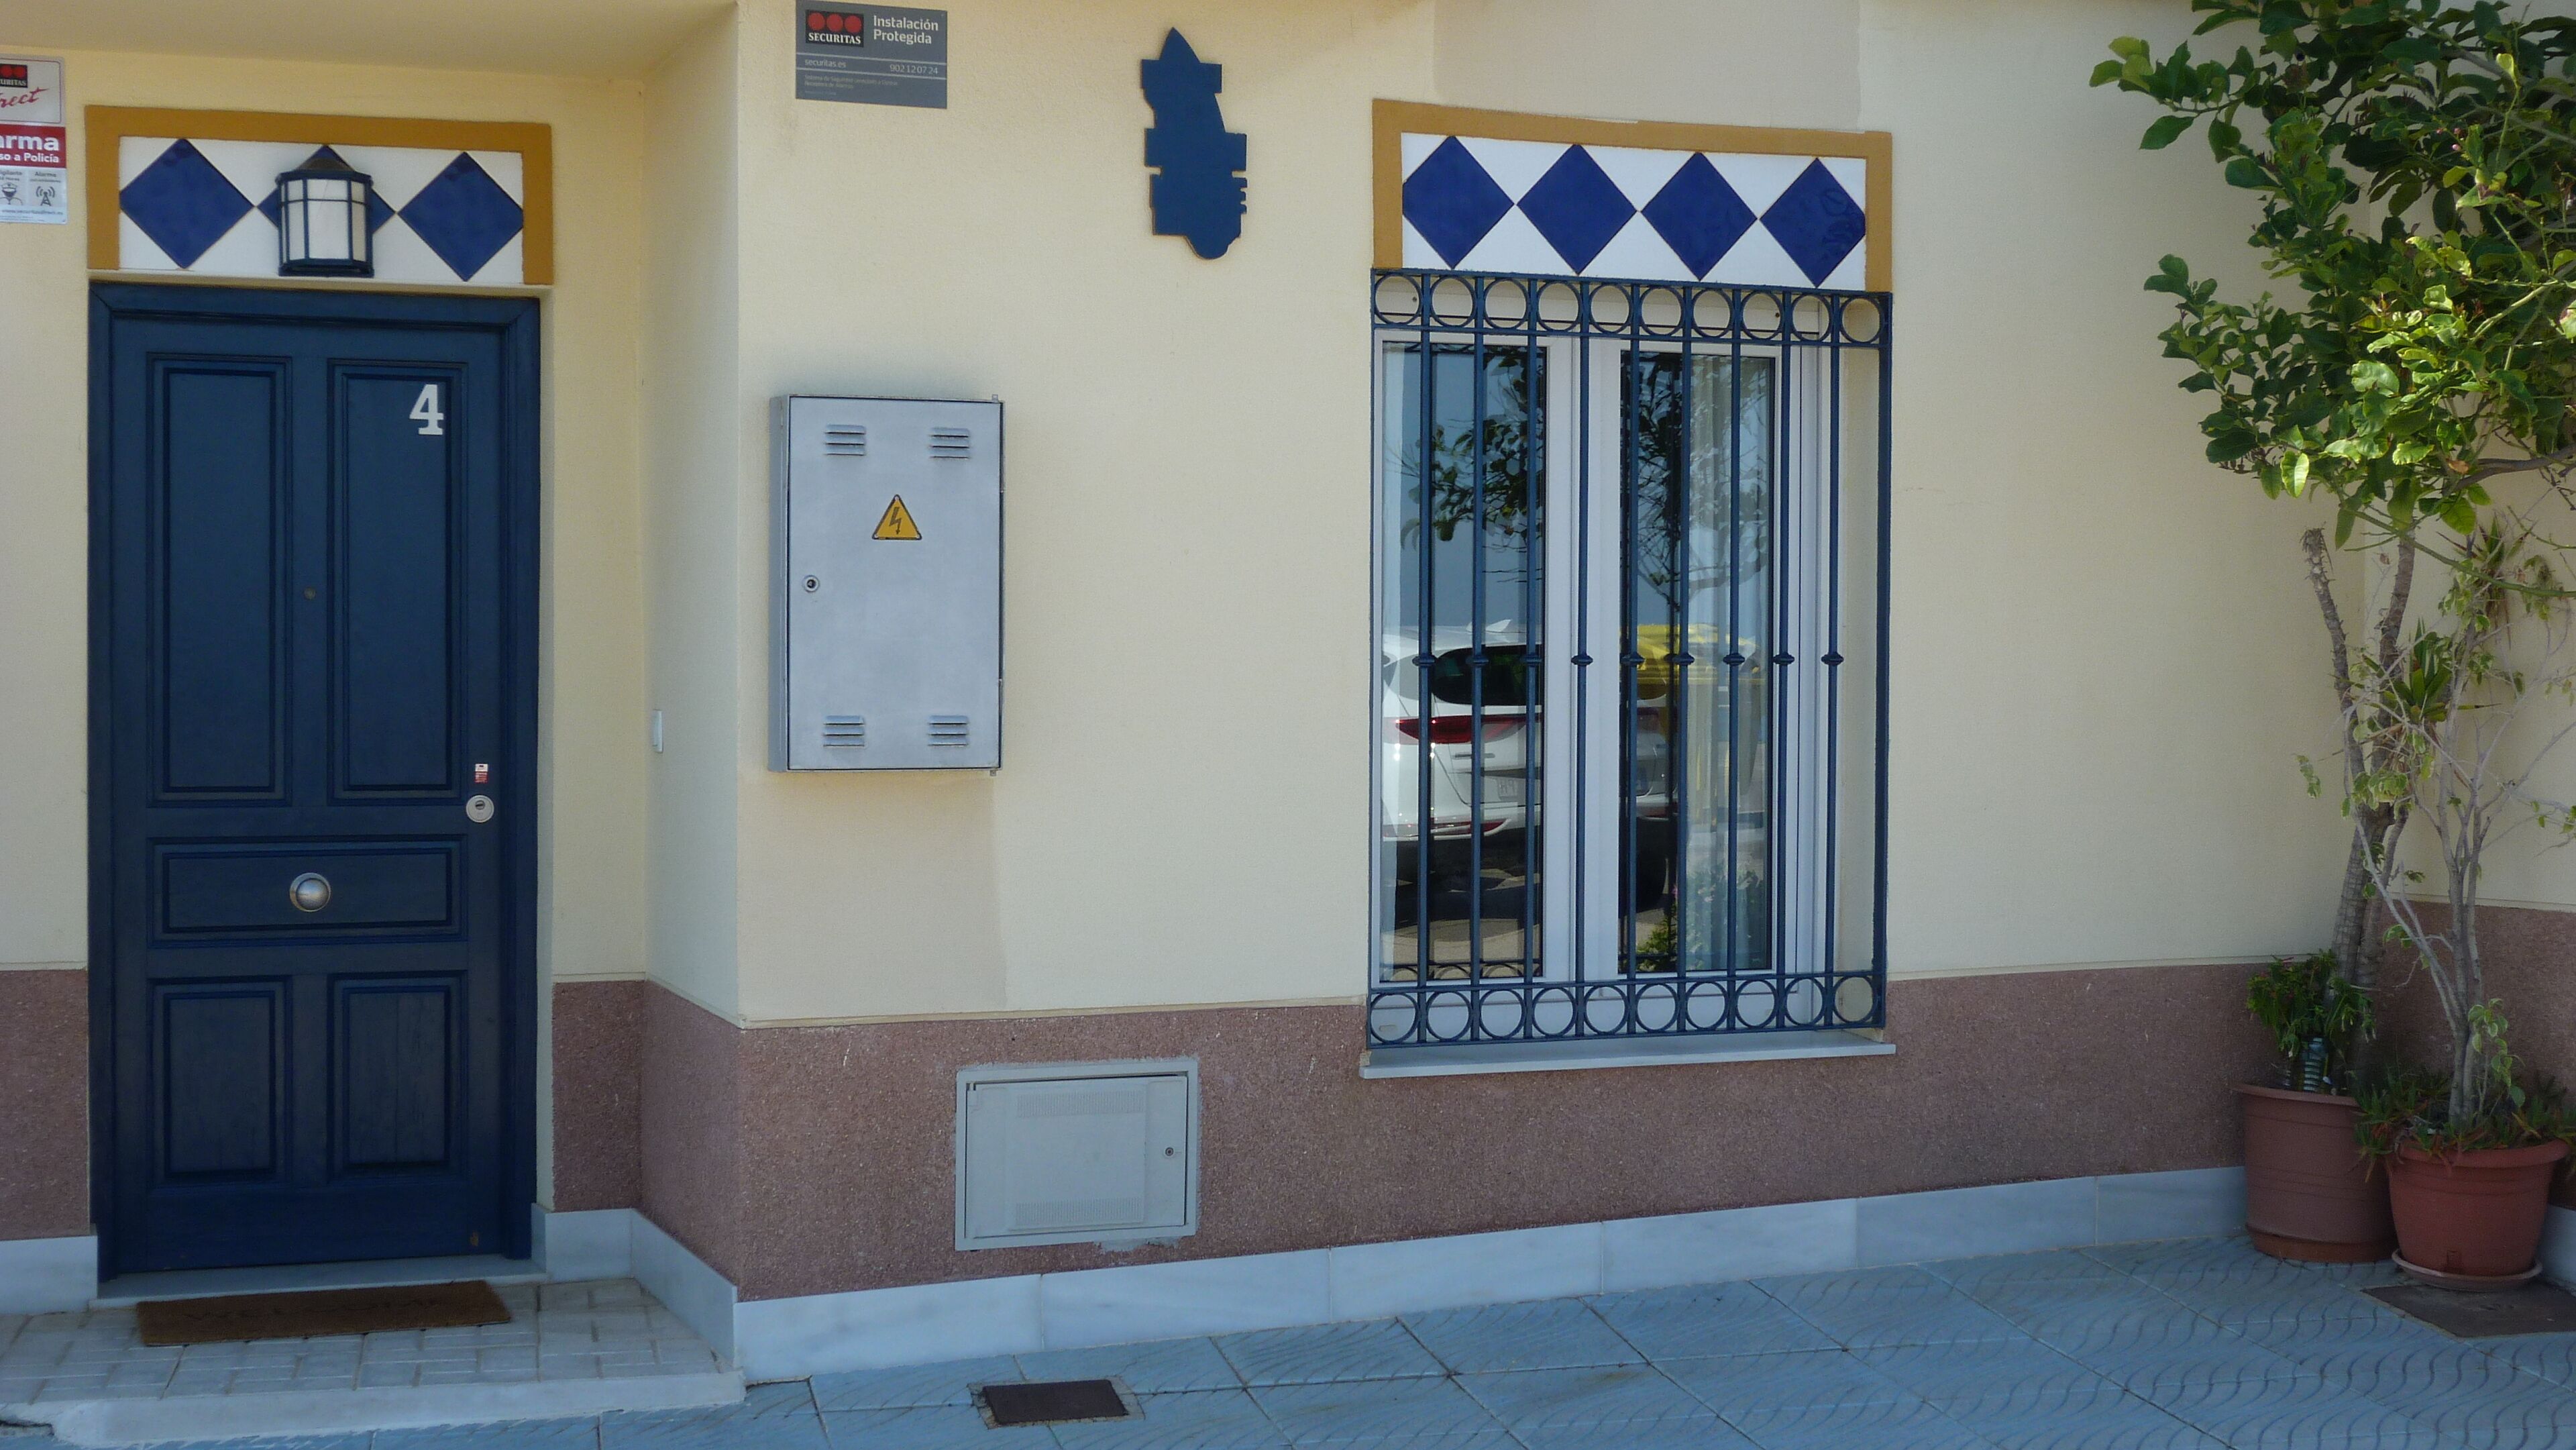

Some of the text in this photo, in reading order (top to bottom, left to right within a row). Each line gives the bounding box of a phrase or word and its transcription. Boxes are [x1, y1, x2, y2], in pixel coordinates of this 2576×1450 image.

[873, 15, 938, 31] Instalación
[808, 32, 861, 44] SECURITAS
[873, 29, 932, 45] Protegida
[24, 152, 59, 162] Policía
[409, 384, 444, 435] 4
